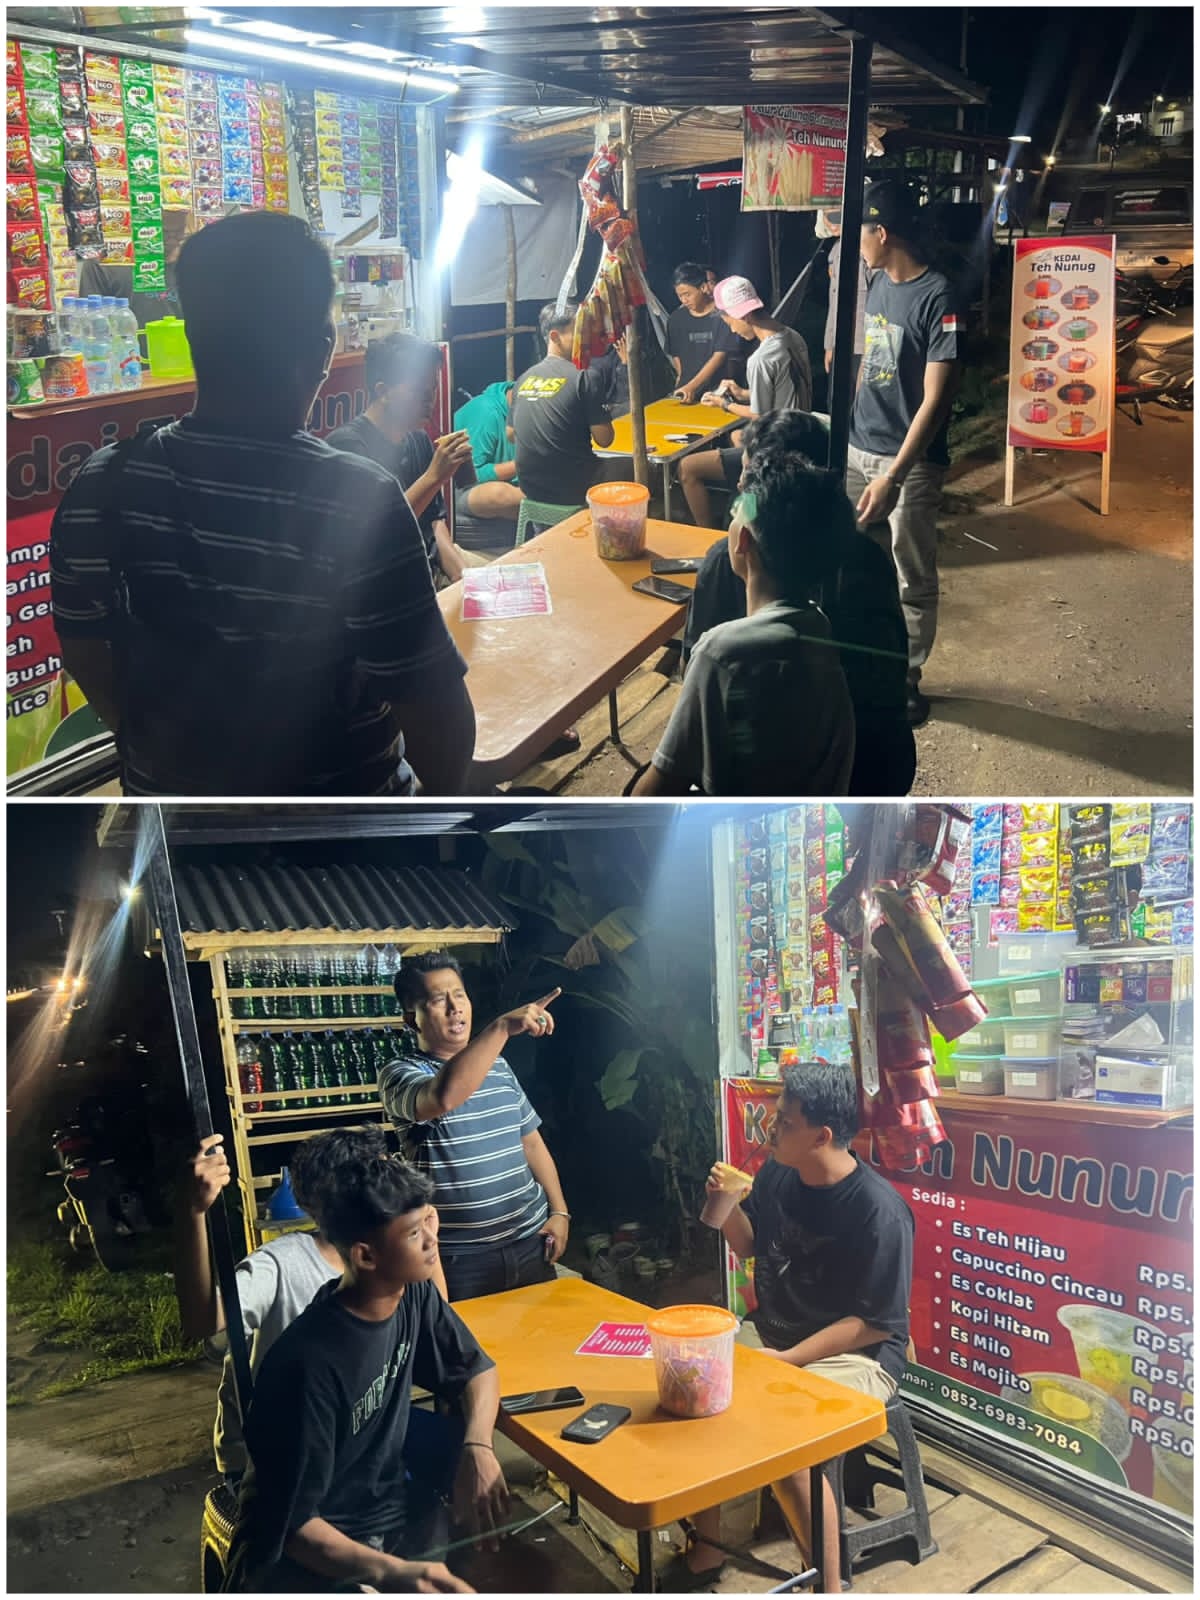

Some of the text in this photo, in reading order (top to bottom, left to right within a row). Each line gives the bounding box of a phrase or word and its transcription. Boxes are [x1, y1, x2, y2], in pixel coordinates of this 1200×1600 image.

[792, 129, 811, 145] Teh
[1031, 263, 1096, 272] Teh Nunug
[1054, 254, 1081, 262] KEDAI
[6, 656, 61, 688] Buah
[911, 1187, 956, 1209] Sedia
[952, 1222, 1065, 1261] Es Teh Hijau
[951, 1274, 1034, 1311] Es Coklat
[952, 1248, 1123, 1307] Capuccino Cincau
[951, 1300, 1050, 1344] Kopi Hitam
[950, 1326, 1011, 1358] Es Milo
[1136, 1328, 1193, 1357] Rp5.
[950, 1351, 1031, 1393] Es Mojito
[902, 1372, 928, 1388] nan
[940, 1385, 1082, 1455] 0852-6983-7084
[1130, 1418, 1193, 1457] Rp5.0
